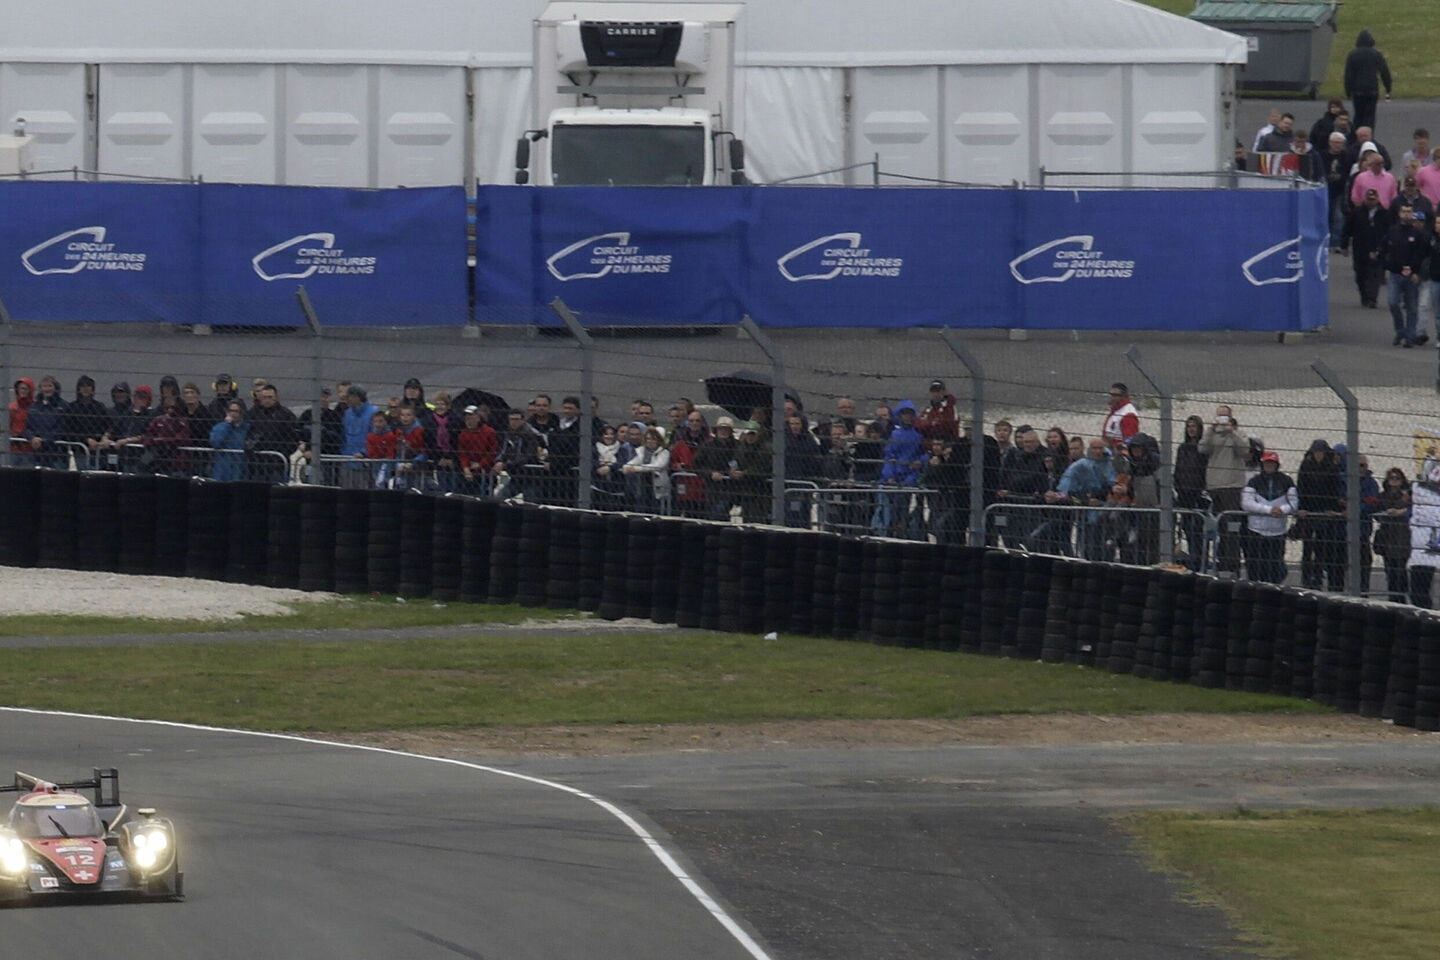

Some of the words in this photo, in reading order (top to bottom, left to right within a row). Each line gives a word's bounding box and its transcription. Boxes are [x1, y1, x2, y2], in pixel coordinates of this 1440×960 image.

[607, 28, 657, 36] CARRIER
[67, 242, 115, 251] CIRCUIT
[593, 246, 639, 255] CIRCUIT
[81, 252, 97, 260] 24
[97, 252, 146, 262] HEURES
[297, 248, 344, 257] CIRCUIT
[823, 248, 871, 257] CIRCUIT
[1055, 250, 1103, 259] CIRCUIT
[312, 256, 327, 265] 24
[328, 257, 376, 266] HEURES
[607, 255, 622, 264] 24
[623, 255, 672, 264] HEURES
[837, 257, 853, 266] 24
[854, 258, 903, 267] HEURES
[86, 261, 104, 270] DU
[104, 261, 144, 271] MANS
[612, 264, 630, 273] DU
[630, 264, 671, 273] MANS
[1070, 260, 1085, 268] 24
[1086, 260, 1135, 269] HEURES
[317, 265, 335, 274] DU
[335, 265, 375, 274] MANS
[842, 266, 860, 276] DU
[860, 267, 901, 277] MANS
[1075, 269, 1092, 278] DU
[1093, 269, 1133, 278] MANS
[64, 855, 96, 866] 12
